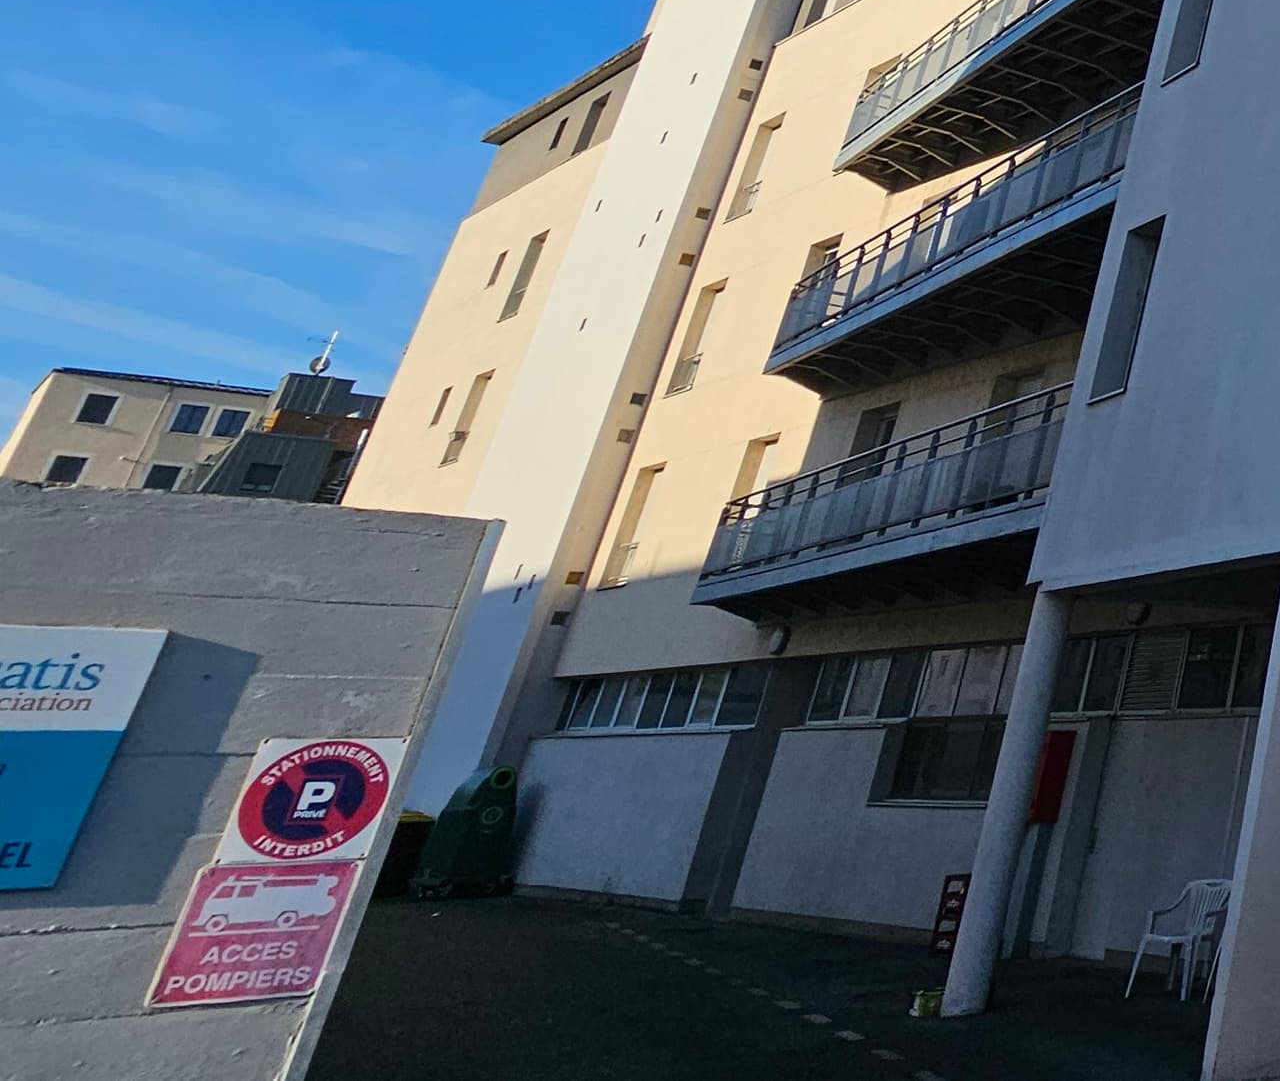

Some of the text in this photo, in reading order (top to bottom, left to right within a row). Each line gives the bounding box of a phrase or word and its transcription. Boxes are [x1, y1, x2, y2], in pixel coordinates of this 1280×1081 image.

[0, 652, 105, 691] atis
[261, 745, 384, 786] STATIONNEMENT
[296, 781, 336, 810] P
[253, 830, 346, 857] INTERDIT
[200, 940, 298, 965] ACCES
[163, 966, 312, 995] POMPIERS
